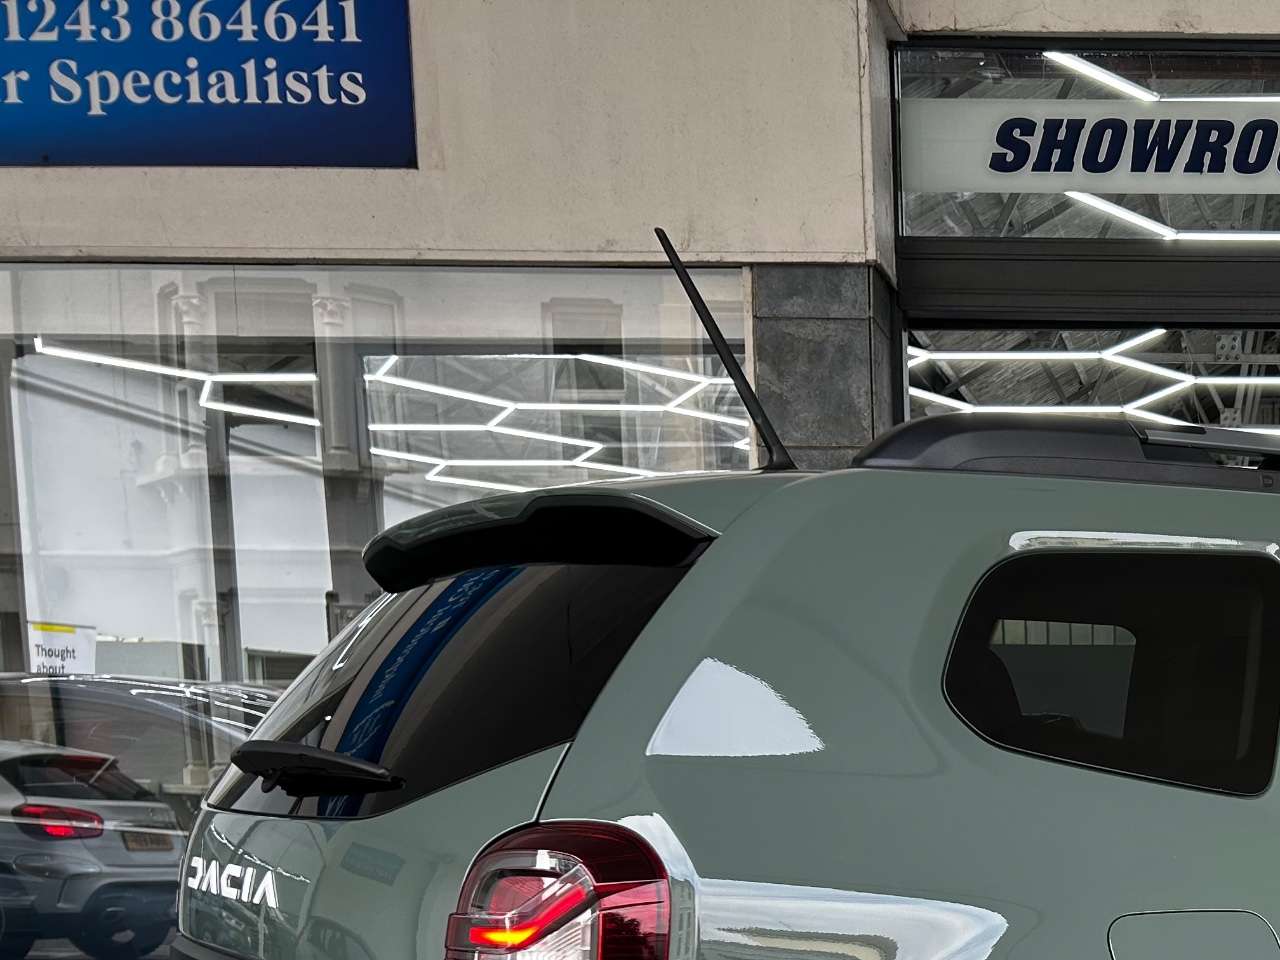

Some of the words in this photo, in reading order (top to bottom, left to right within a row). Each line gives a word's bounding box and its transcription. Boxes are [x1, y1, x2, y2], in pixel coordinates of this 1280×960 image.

[151, 0, 363, 42] 864641
[49, 57, 367, 116] Specialists
[34, 643, 77, 662] Thought
[187, 855, 279, 909] DACIA
